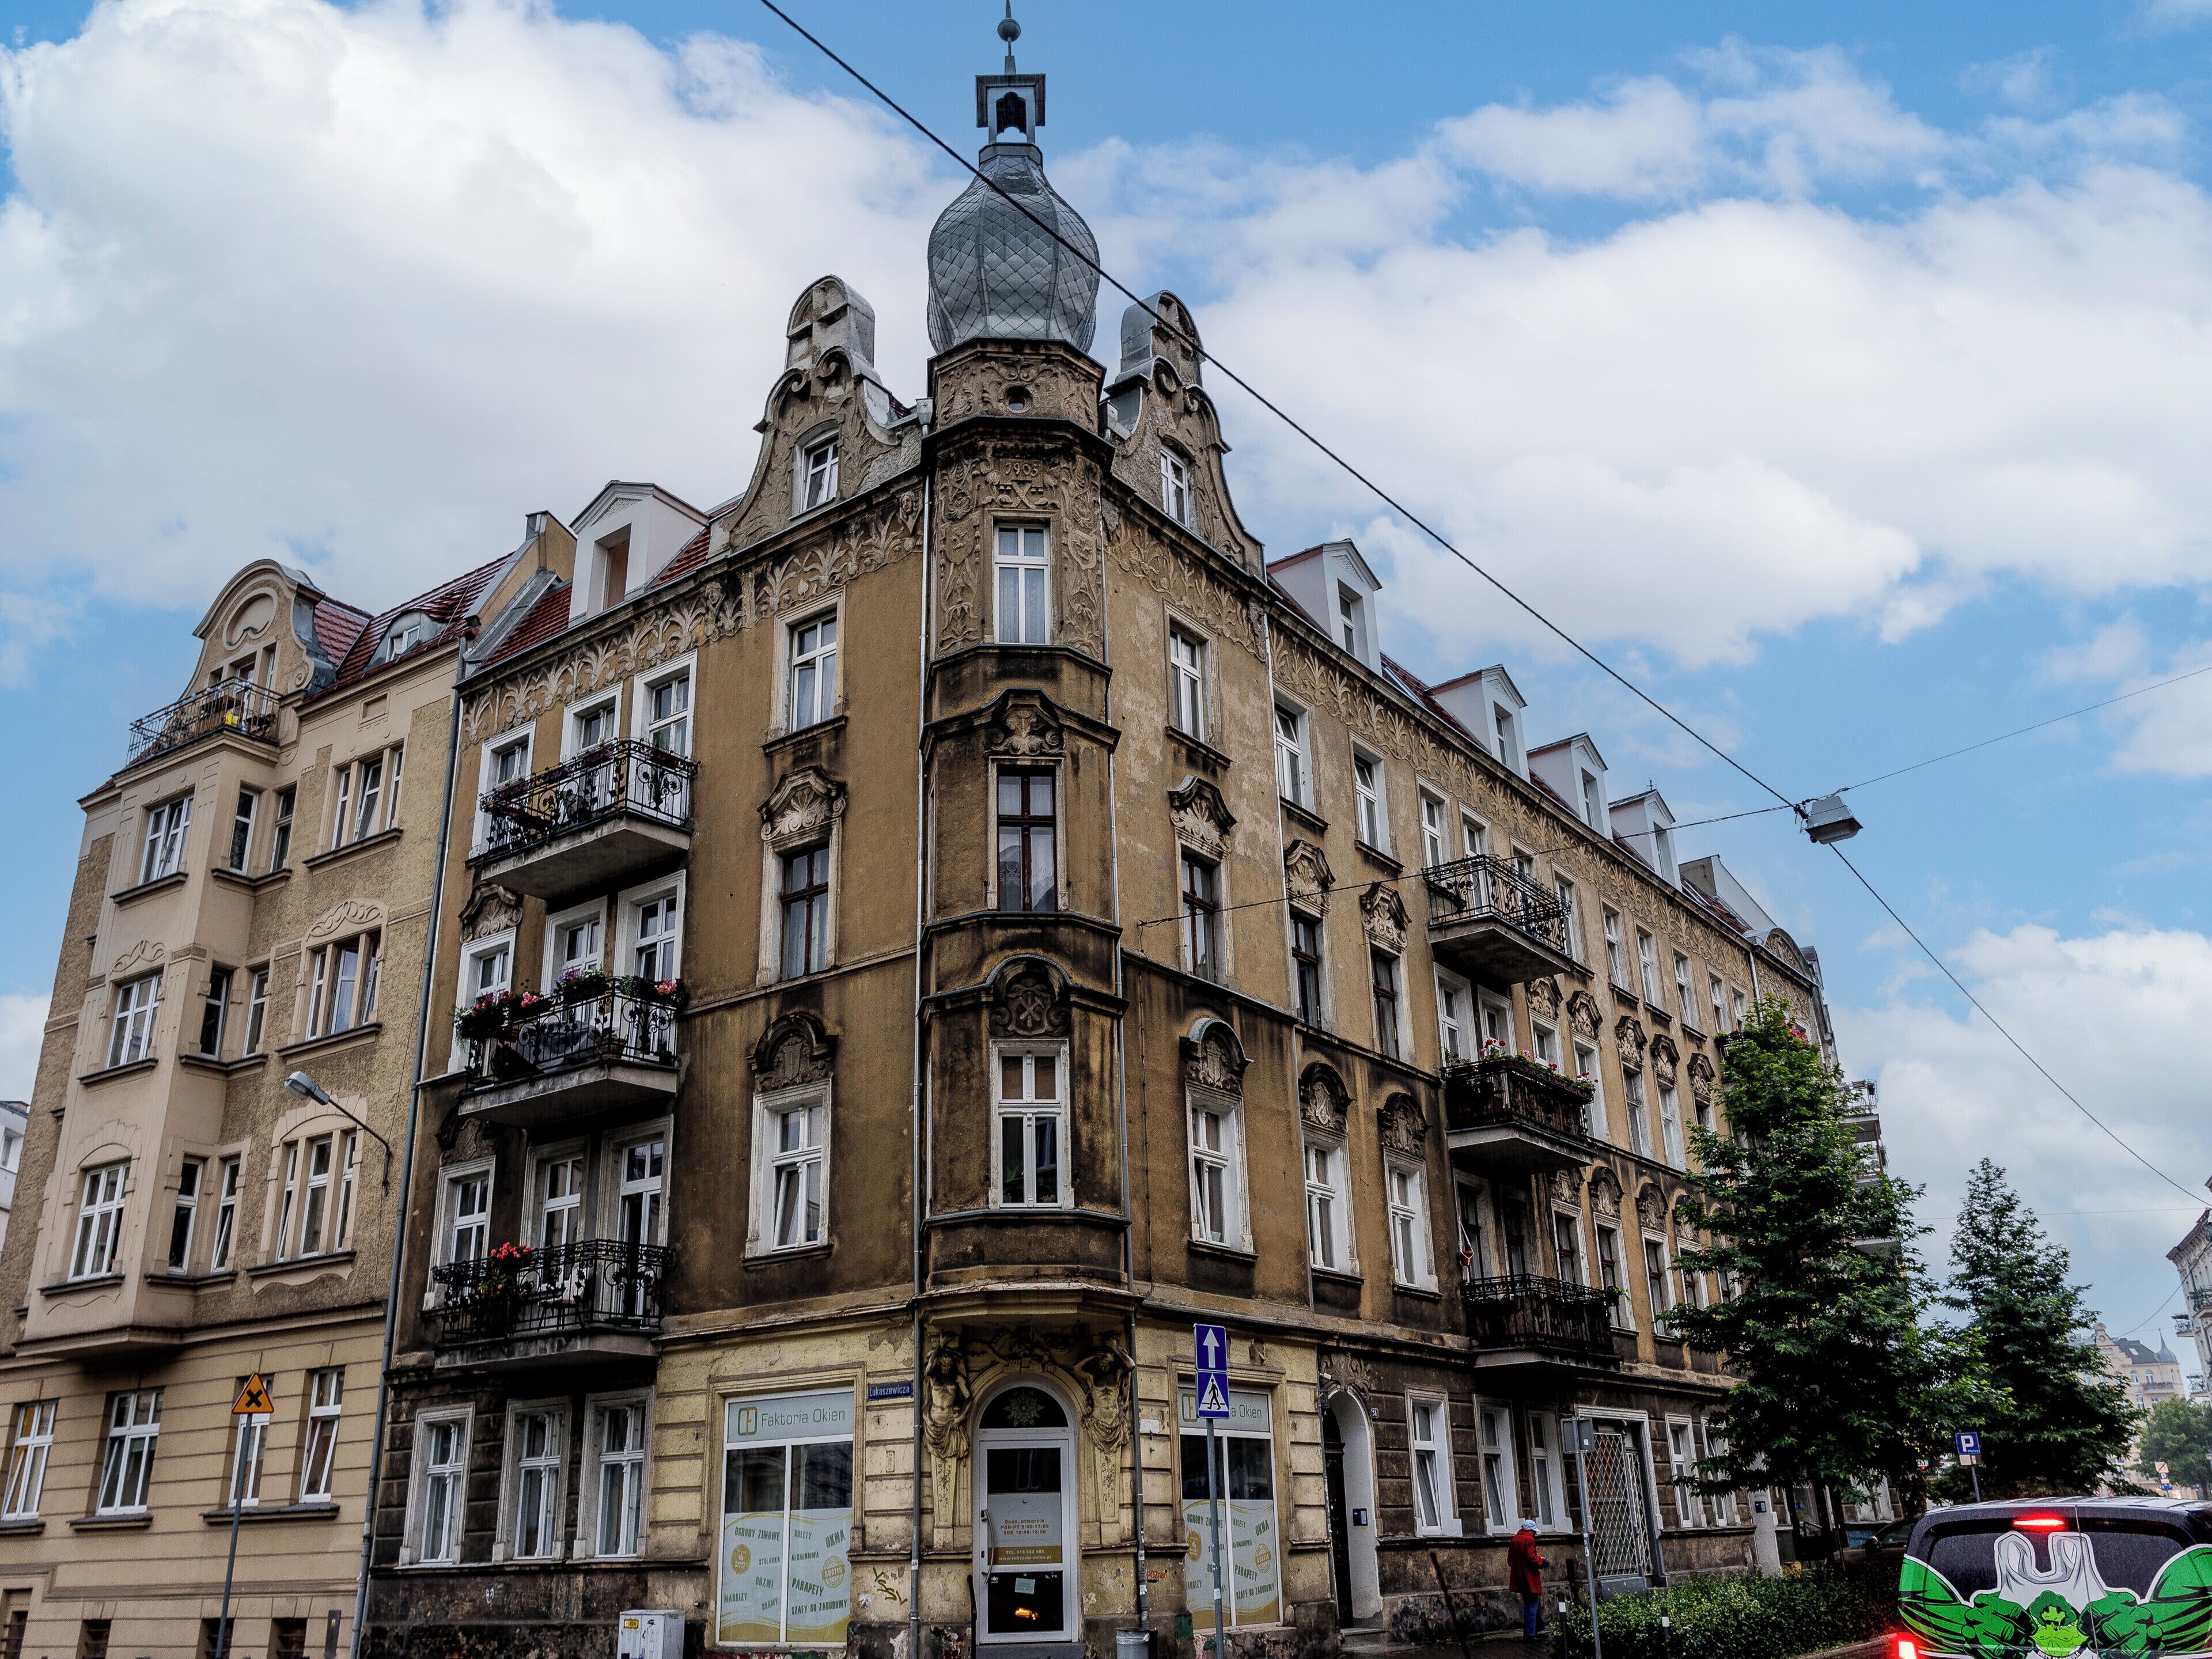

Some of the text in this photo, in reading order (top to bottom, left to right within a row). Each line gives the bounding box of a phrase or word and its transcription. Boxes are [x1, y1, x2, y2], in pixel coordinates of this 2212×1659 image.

[869, 1384, 910, 1396] Łukaszewicza
[761, 1408, 845, 1427] Faktoria Okien
[1239, 1404, 1262, 1418] Okien
[1960, 1435, 1974, 1452] P
[1187, 1513, 1203, 1525] OGRODY
[734, 1527, 780, 1541] OGRODY ZIMOWE
[794, 1529, 812, 1540] ROLETY
[1256, 1519, 1270, 1536] OKNA
[825, 1529, 846, 1548] OKNA
[1235, 1564, 1257, 1581] PARAPETY
[755, 1576, 774, 1589] DRZWI
[791, 1578, 824, 1597] PARAPETY
[724, 1592, 747, 1603] MARKIZY
[791, 1604, 808, 1615] SZAFY
[819, 1599, 847, 1611] ZABUDOWY
